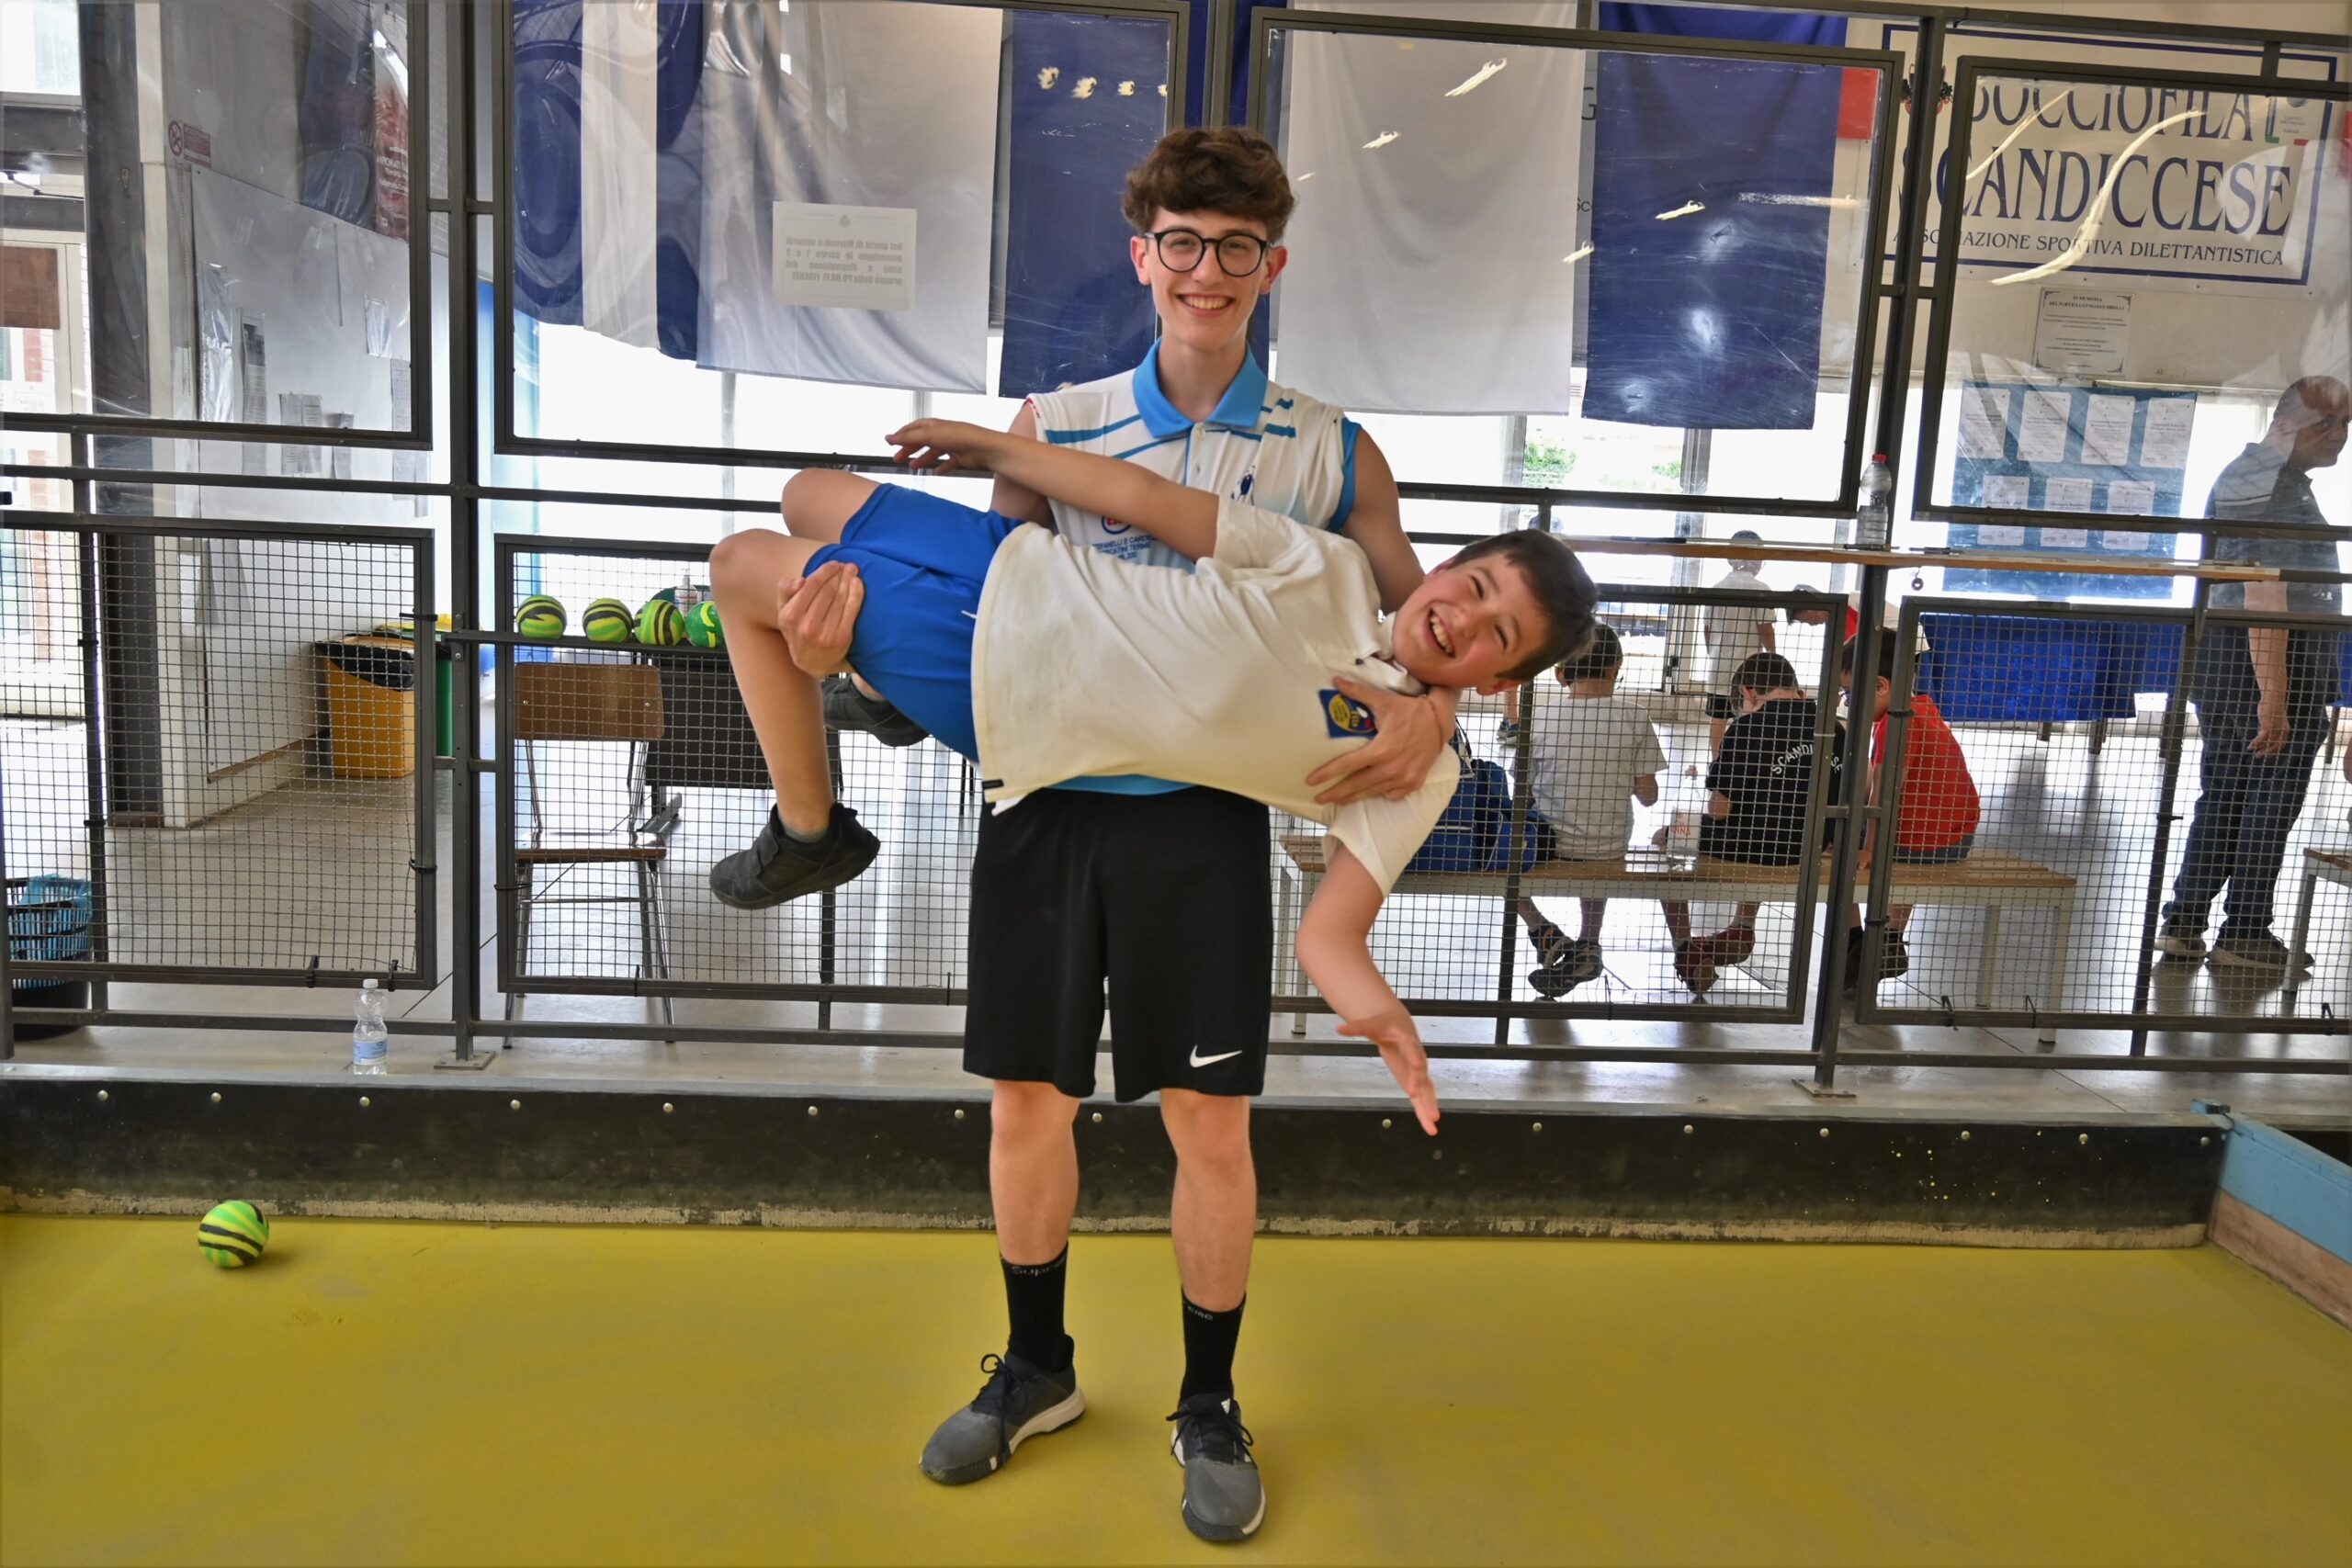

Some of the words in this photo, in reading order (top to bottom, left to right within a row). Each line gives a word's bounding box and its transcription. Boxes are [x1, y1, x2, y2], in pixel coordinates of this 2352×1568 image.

[1897, 145, 2291, 238] CANDICCESE
[2131, 242, 2284, 265] DILETTANTISTICA
[1770, 744, 1843, 774] SCANDISE
